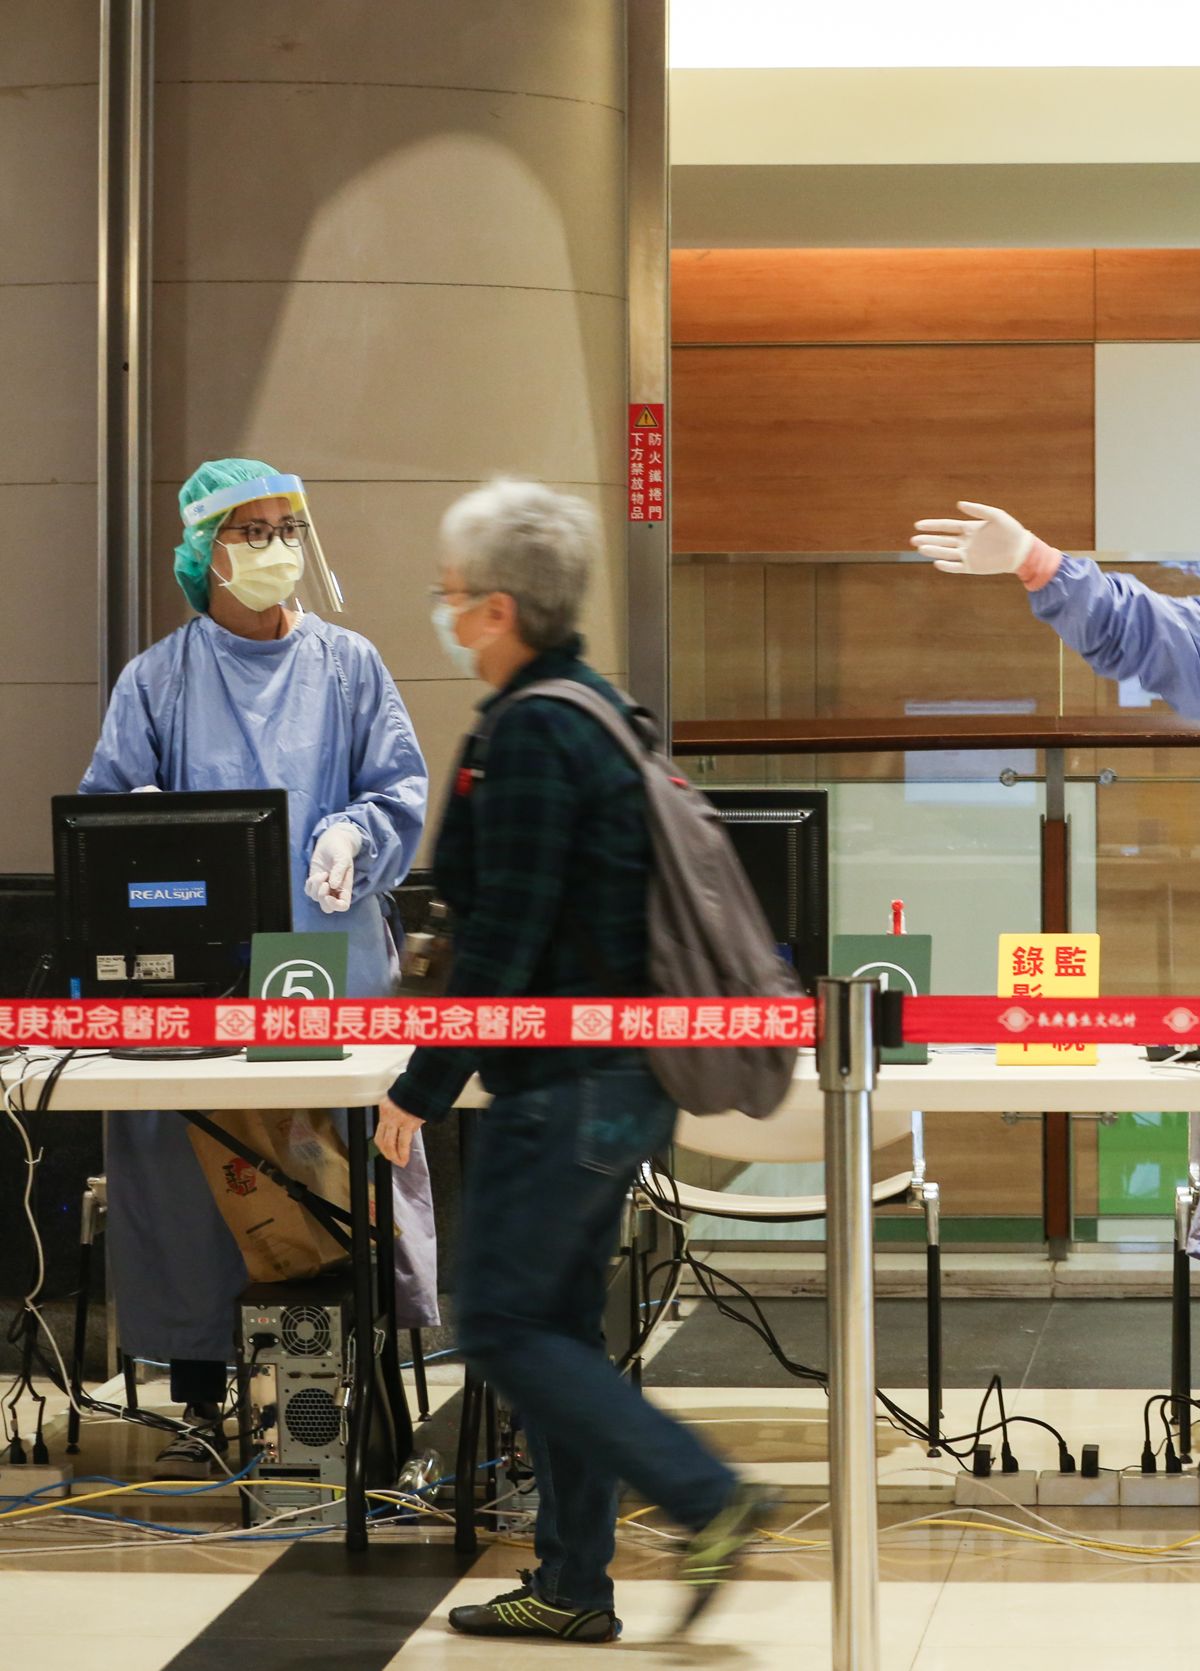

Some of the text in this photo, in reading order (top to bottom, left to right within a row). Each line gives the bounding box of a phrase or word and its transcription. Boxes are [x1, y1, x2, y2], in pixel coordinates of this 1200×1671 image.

[631, 432, 645, 519] 下方禁放物品
[130, 888, 206, 901] REALsync
[262, 1005, 546, 1041] 桃園長庚紀念醫院
